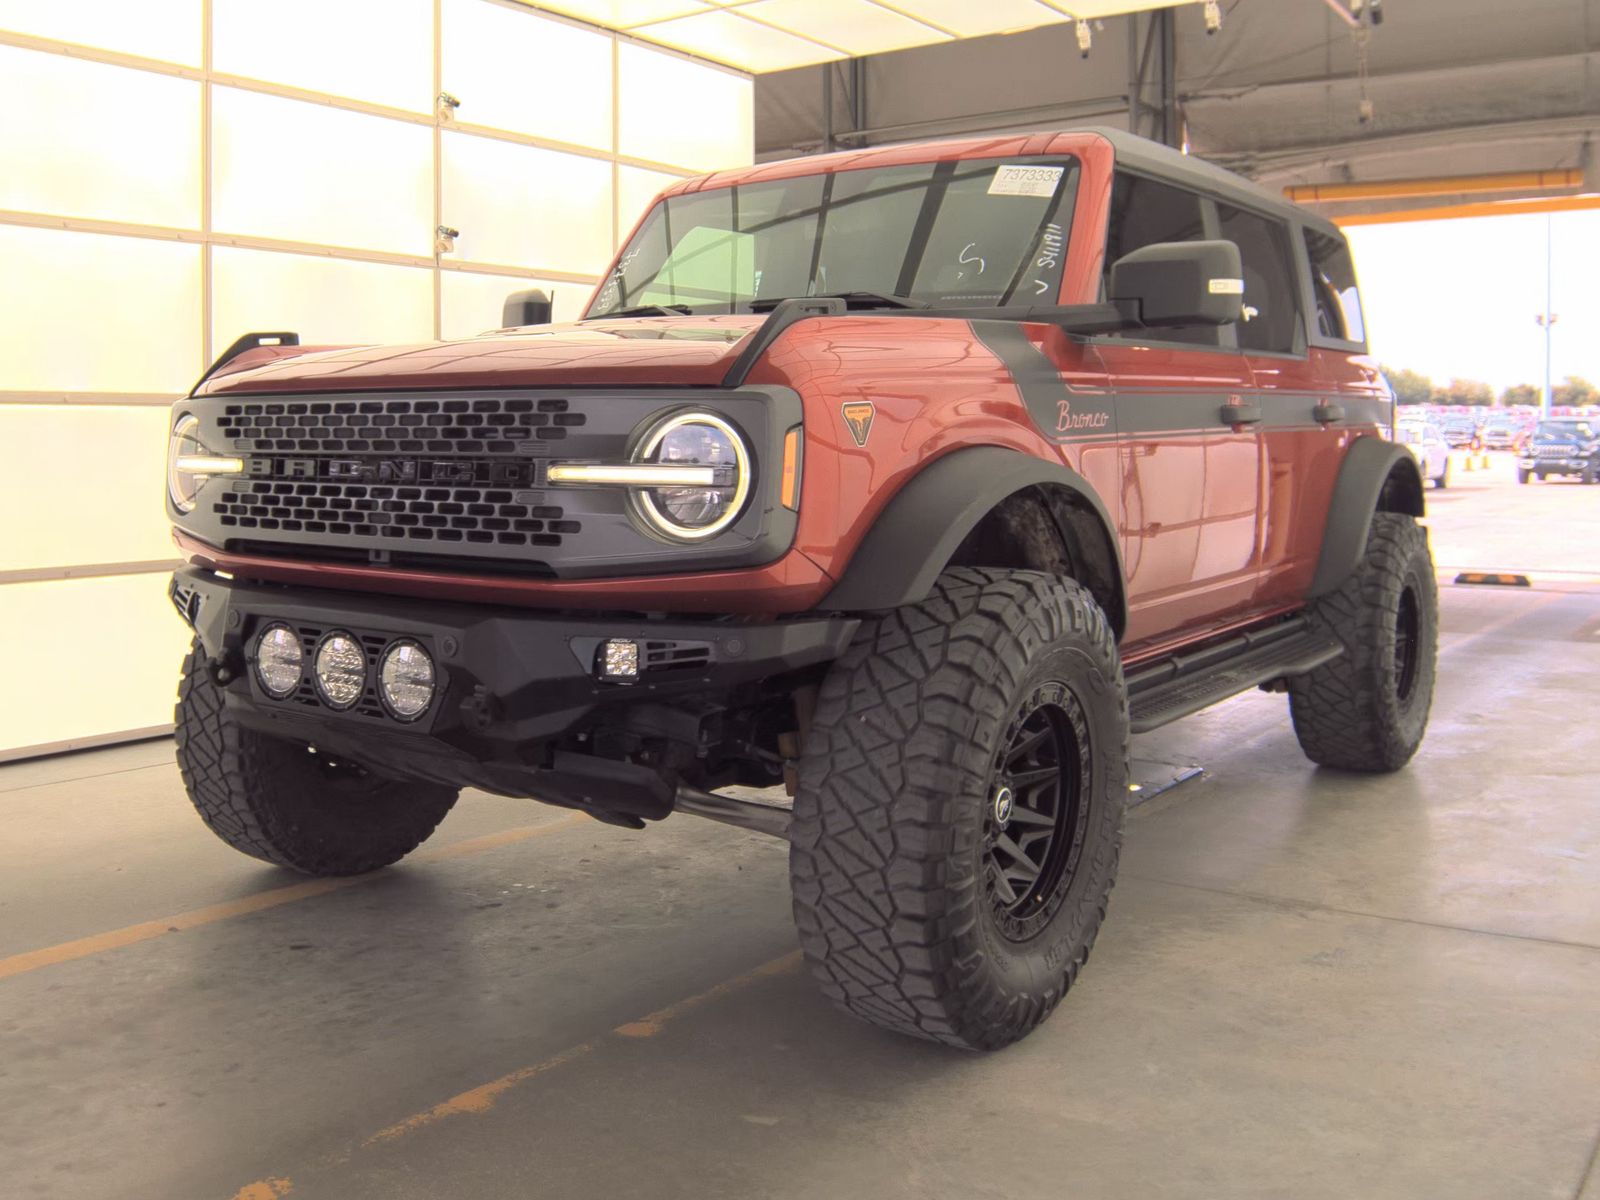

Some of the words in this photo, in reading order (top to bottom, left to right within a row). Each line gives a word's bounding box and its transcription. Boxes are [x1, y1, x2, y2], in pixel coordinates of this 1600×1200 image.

[1003, 168, 1062, 183] 7373333
[1055, 399, 1110, 432] Bronco
[249, 457, 534, 484] BRONCO
